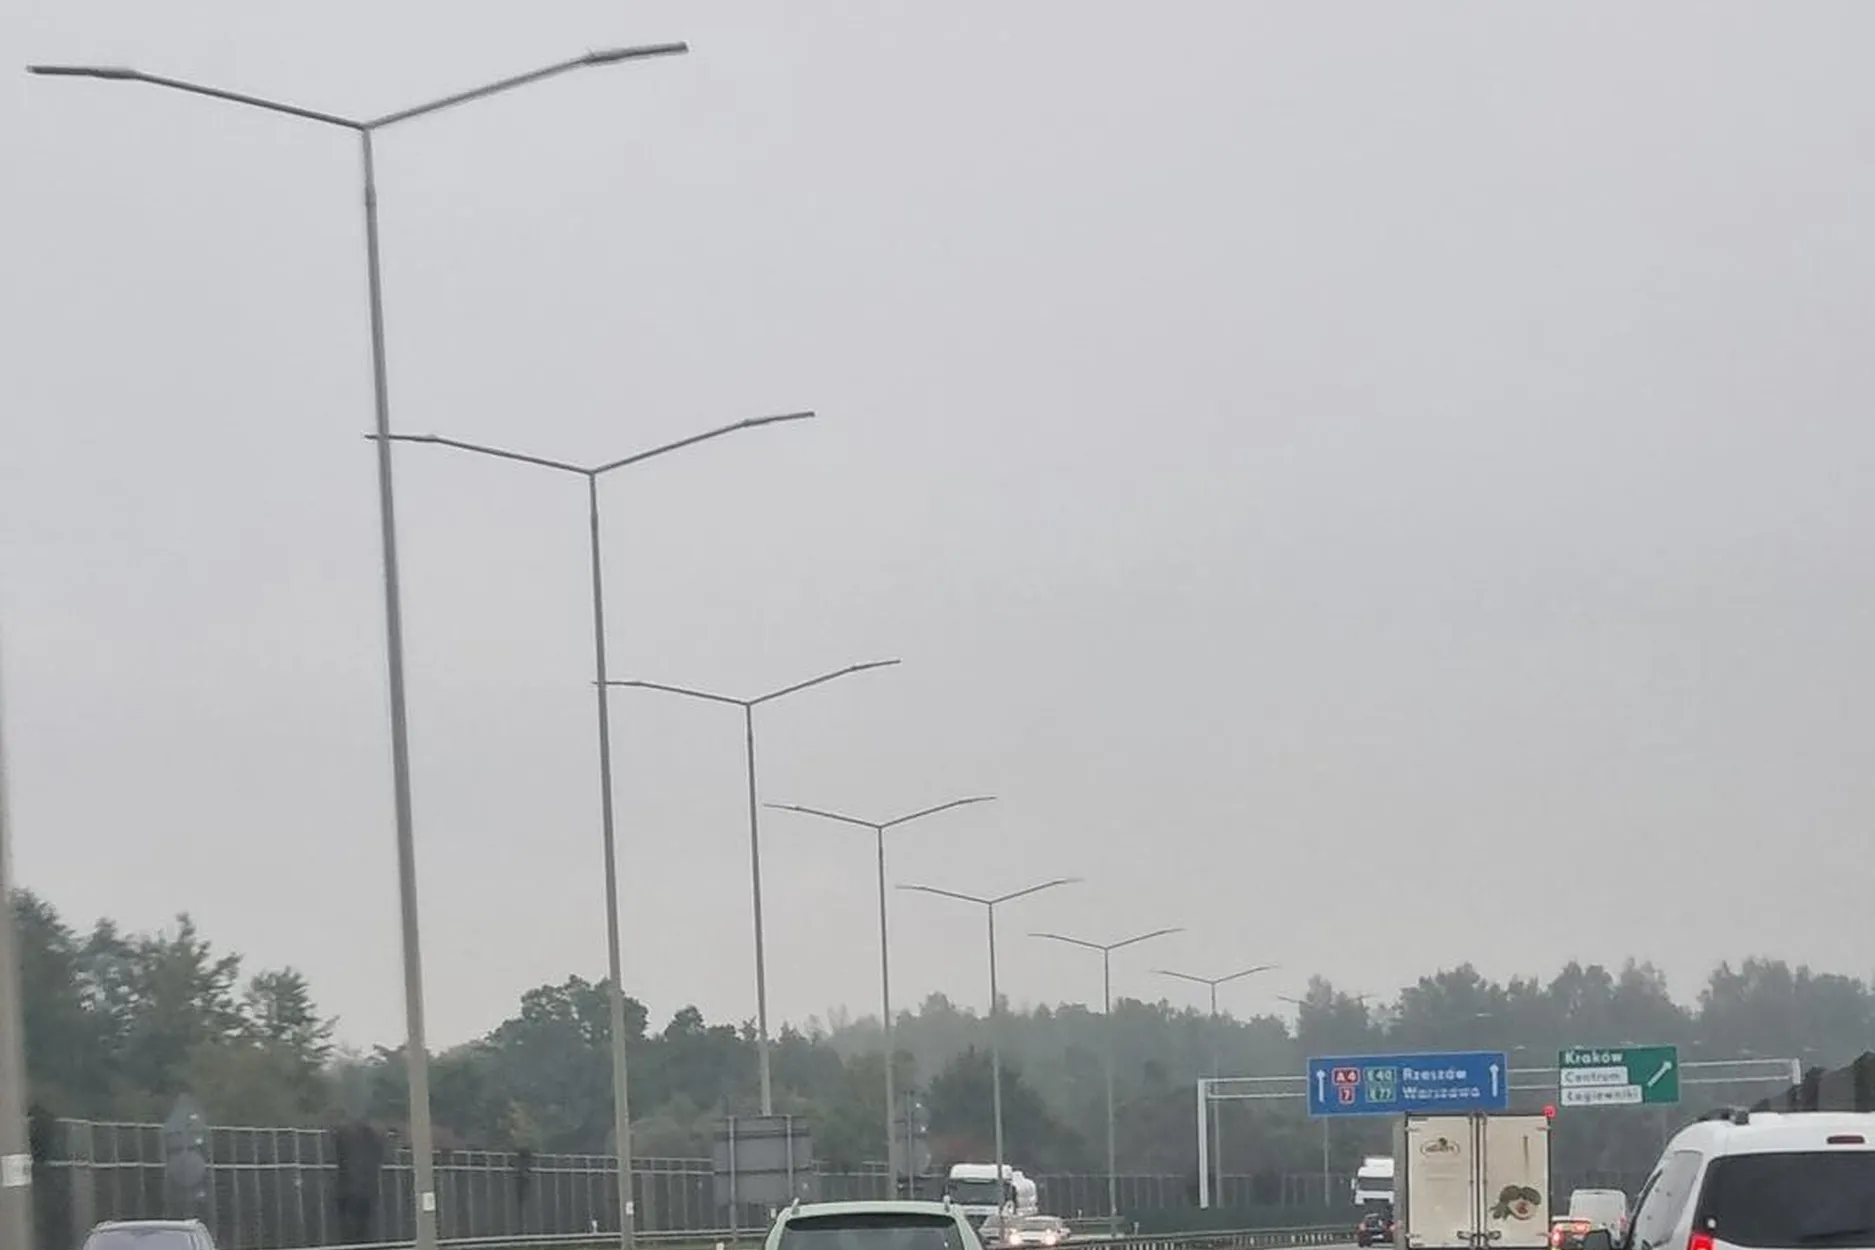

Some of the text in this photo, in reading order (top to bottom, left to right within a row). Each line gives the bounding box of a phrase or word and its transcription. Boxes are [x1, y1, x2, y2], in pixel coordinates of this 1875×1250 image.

[1564, 1050, 1623, 1064] Kraków
[1402, 1067, 1468, 1081] Rzeszów
[1564, 1070, 1624, 1083] Centrum
[1402, 1086, 1482, 1099] Warszawa
